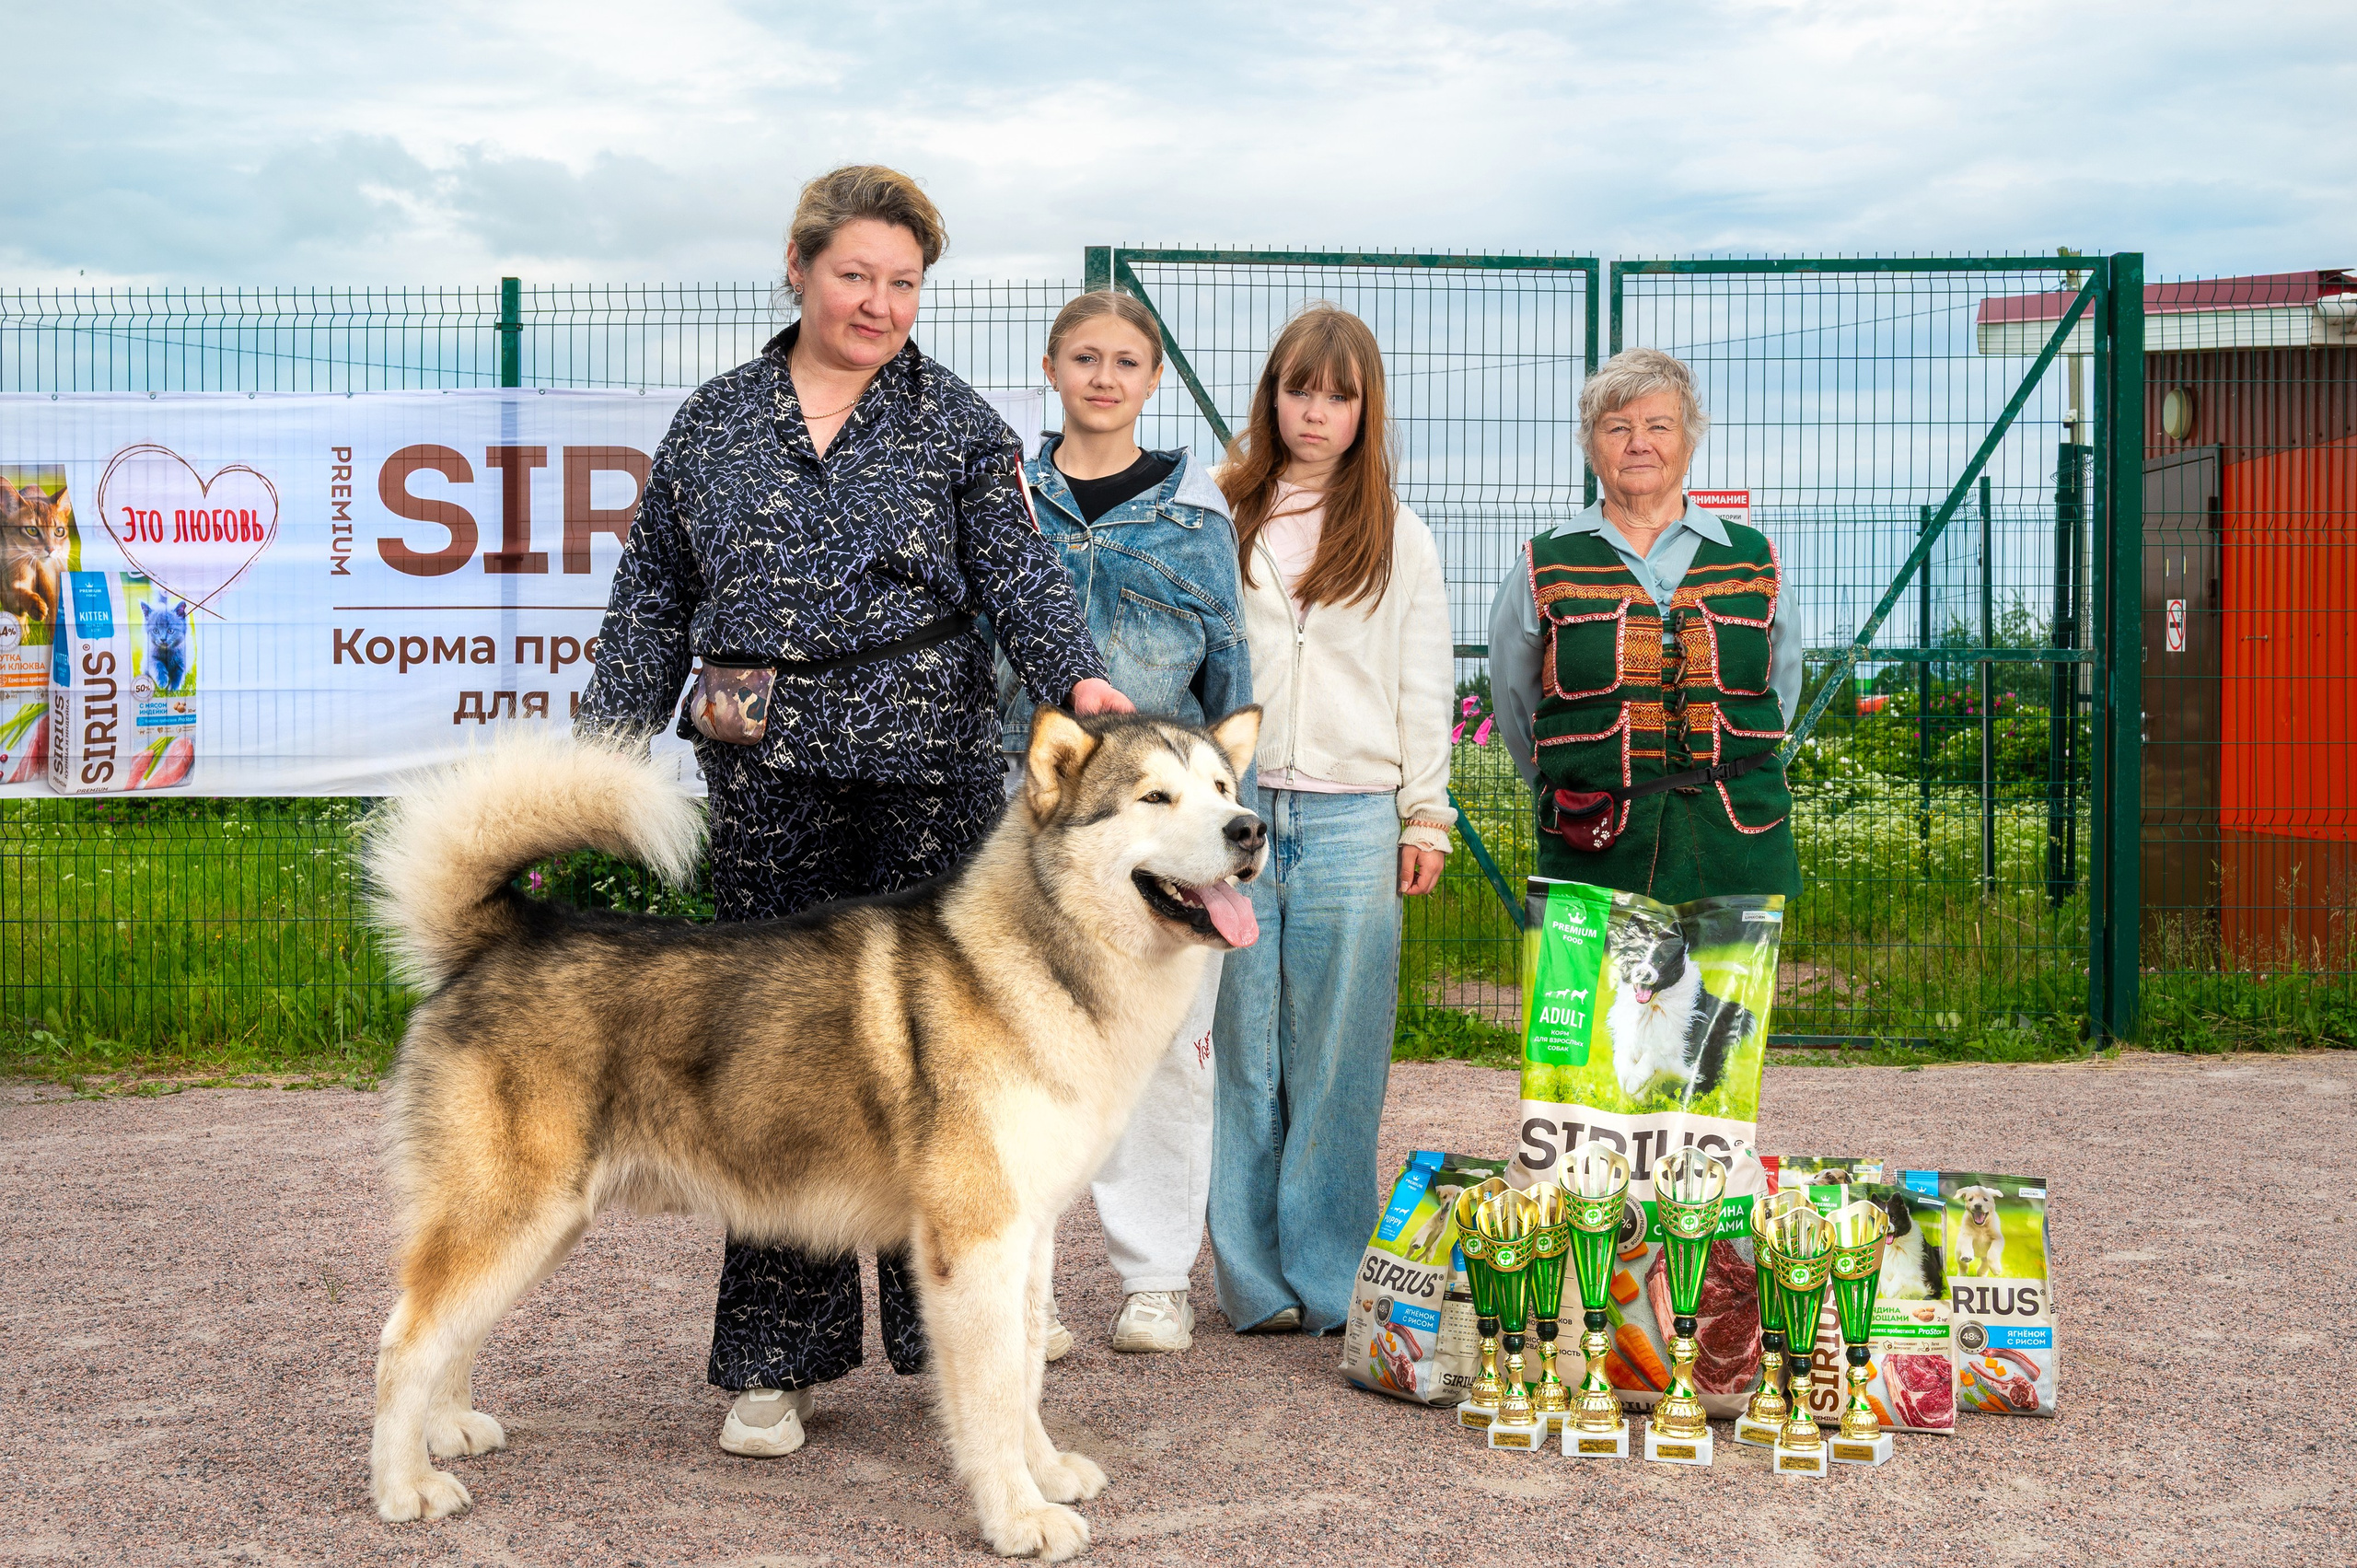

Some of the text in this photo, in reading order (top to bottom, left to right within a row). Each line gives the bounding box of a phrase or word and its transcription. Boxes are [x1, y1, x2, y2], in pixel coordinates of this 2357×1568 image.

[1690, 495, 1747, 505] ВНИМАНИЕ
[331, 447, 353, 575] PREMIUM
[122, 506, 264, 543] ЭТО ЛЮБОВЬ
[79, 611, 109, 621] KITTEN
[0, 626, 17, 637] 4%
[0, 654, 21, 662] УТКА
[333, 628, 496, 674] Корма
[135, 684, 151, 692] 50%
[453, 691, 549, 725] для
[81, 651, 118, 784] SIRIUS
[53, 693, 64, 775] SIRIUS
[1552, 921, 1597, 938] PREMIUM
[1562, 935, 1584, 946] FOOD
[1539, 1006, 1585, 1029] ADULT
[1549, 1038, 1584, 1048] ВЗРОСЛЫХ
[1518, 1118, 1734, 1182] SIRIUS
[1384, 1214, 1403, 1227] PUPPY
[1363, 1256, 1437, 1298] SIRIUS
[1952, 1285, 2039, 1317] RIUS
[1404, 1307, 1435, 1321] ЯГНЁНОК
[1408, 1317, 1434, 1329] РИСОМ
[1962, 1332, 1981, 1342] 48%
[2007, 1329, 2046, 1338] ЯГНЁНОК
[1809, 1283, 1840, 1412] SIRIUS
